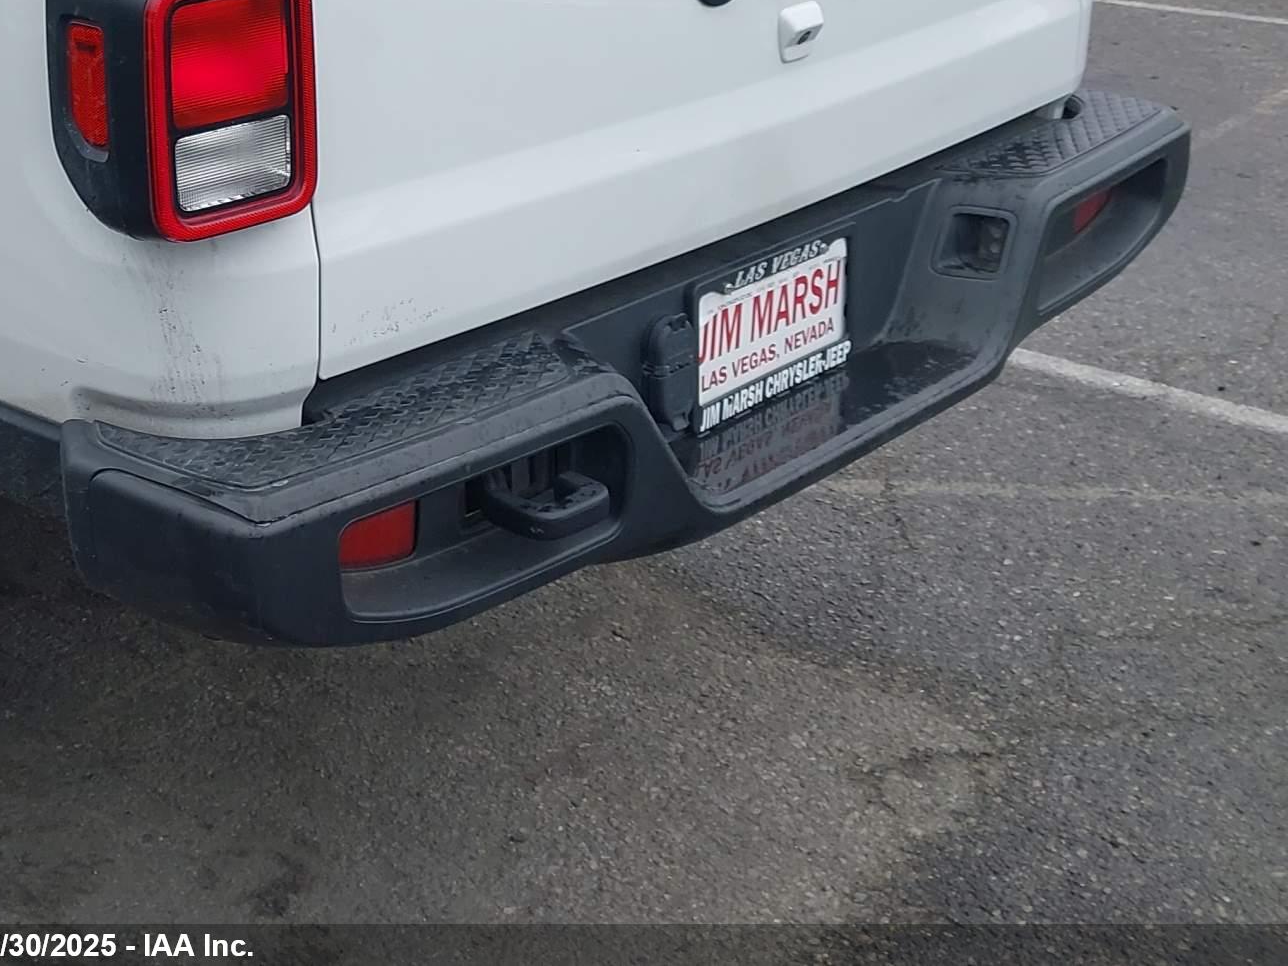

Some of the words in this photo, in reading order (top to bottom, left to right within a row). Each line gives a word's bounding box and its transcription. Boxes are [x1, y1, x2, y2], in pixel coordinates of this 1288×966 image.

[734, 260, 768, 289] LAS
[770, 239, 822, 274] VEGAS
[697, 302, 743, 364] JIM
[749, 260, 841, 343] MARSH
[700, 366, 728, 393] LAS
[731, 343, 781, 379] VEGAS,
[784, 317, 835, 355] NEVADA
[699, 401, 722, 433] JIM
[721, 379, 764, 421] MARSH
